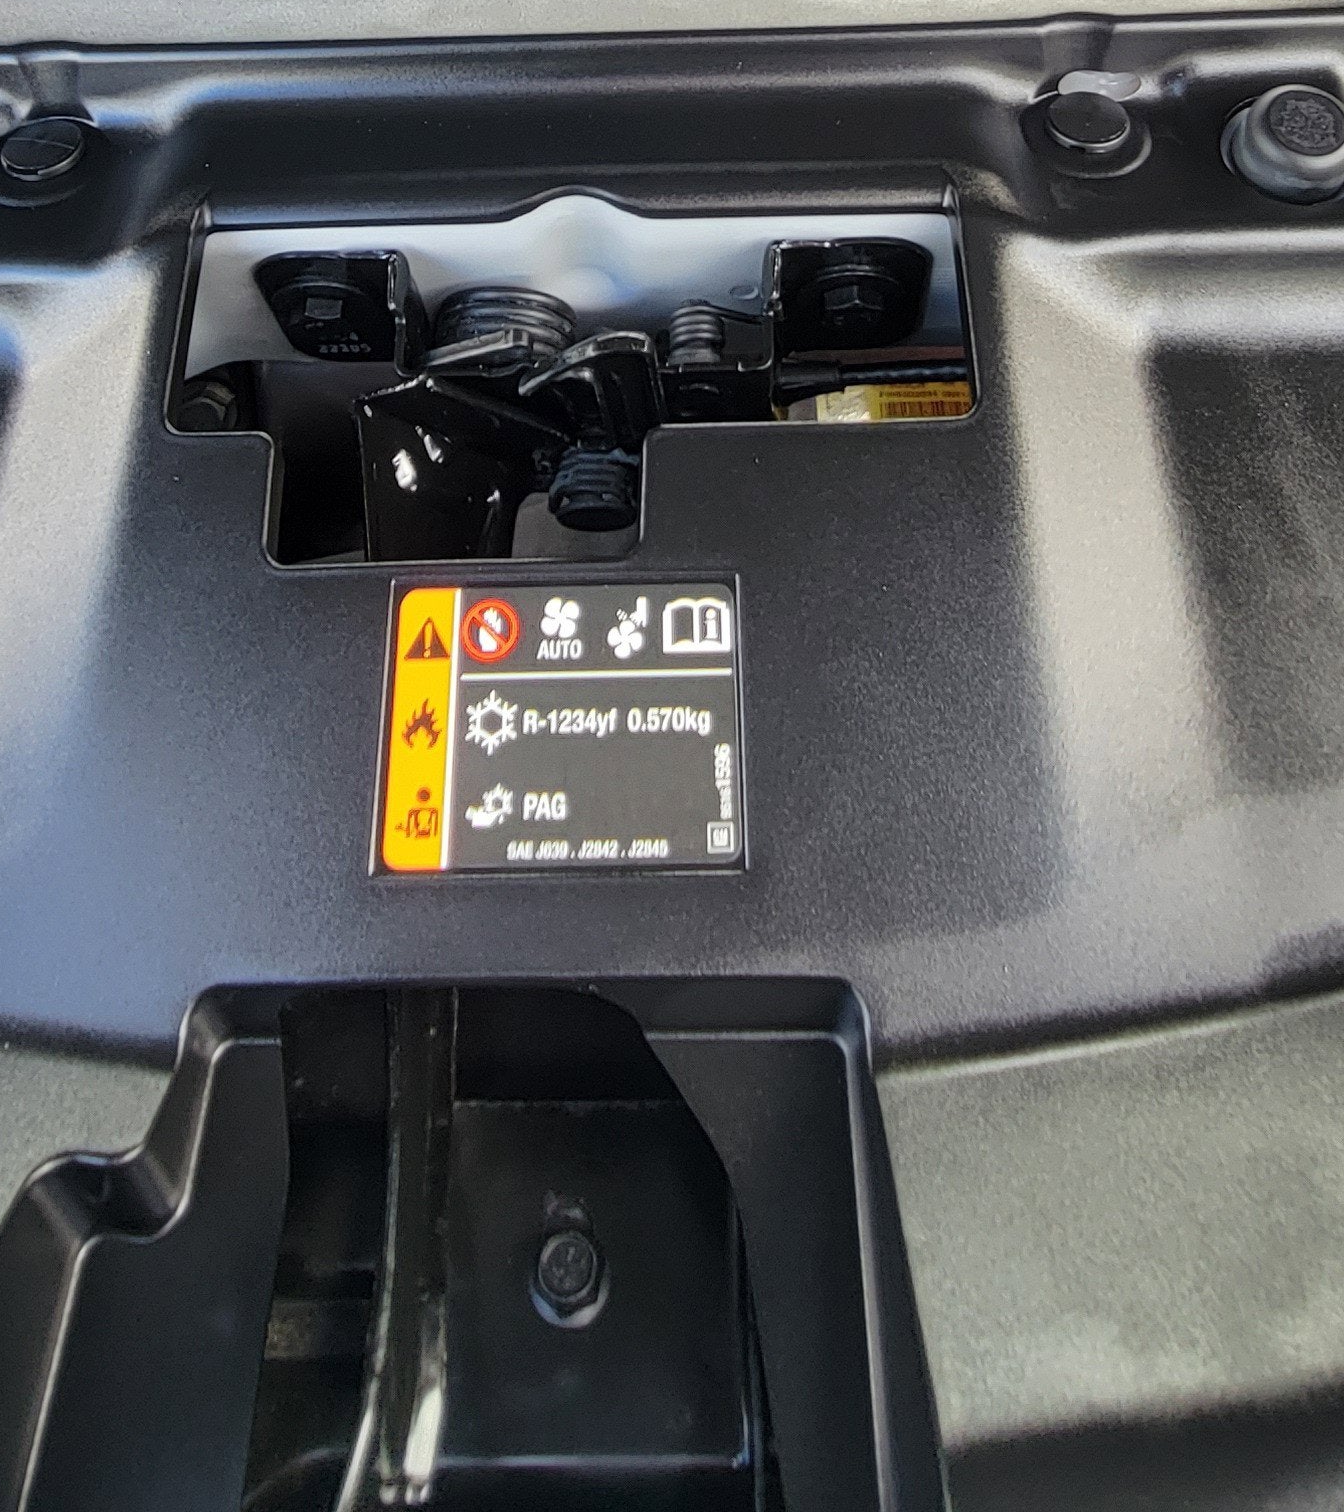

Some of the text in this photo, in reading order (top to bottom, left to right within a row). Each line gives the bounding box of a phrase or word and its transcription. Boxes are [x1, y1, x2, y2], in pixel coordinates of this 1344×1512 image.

[536, 639, 582, 660] AUTO
[522, 706, 711, 737] R-1234yf 0.570kg
[522, 791, 568, 821] PAG
